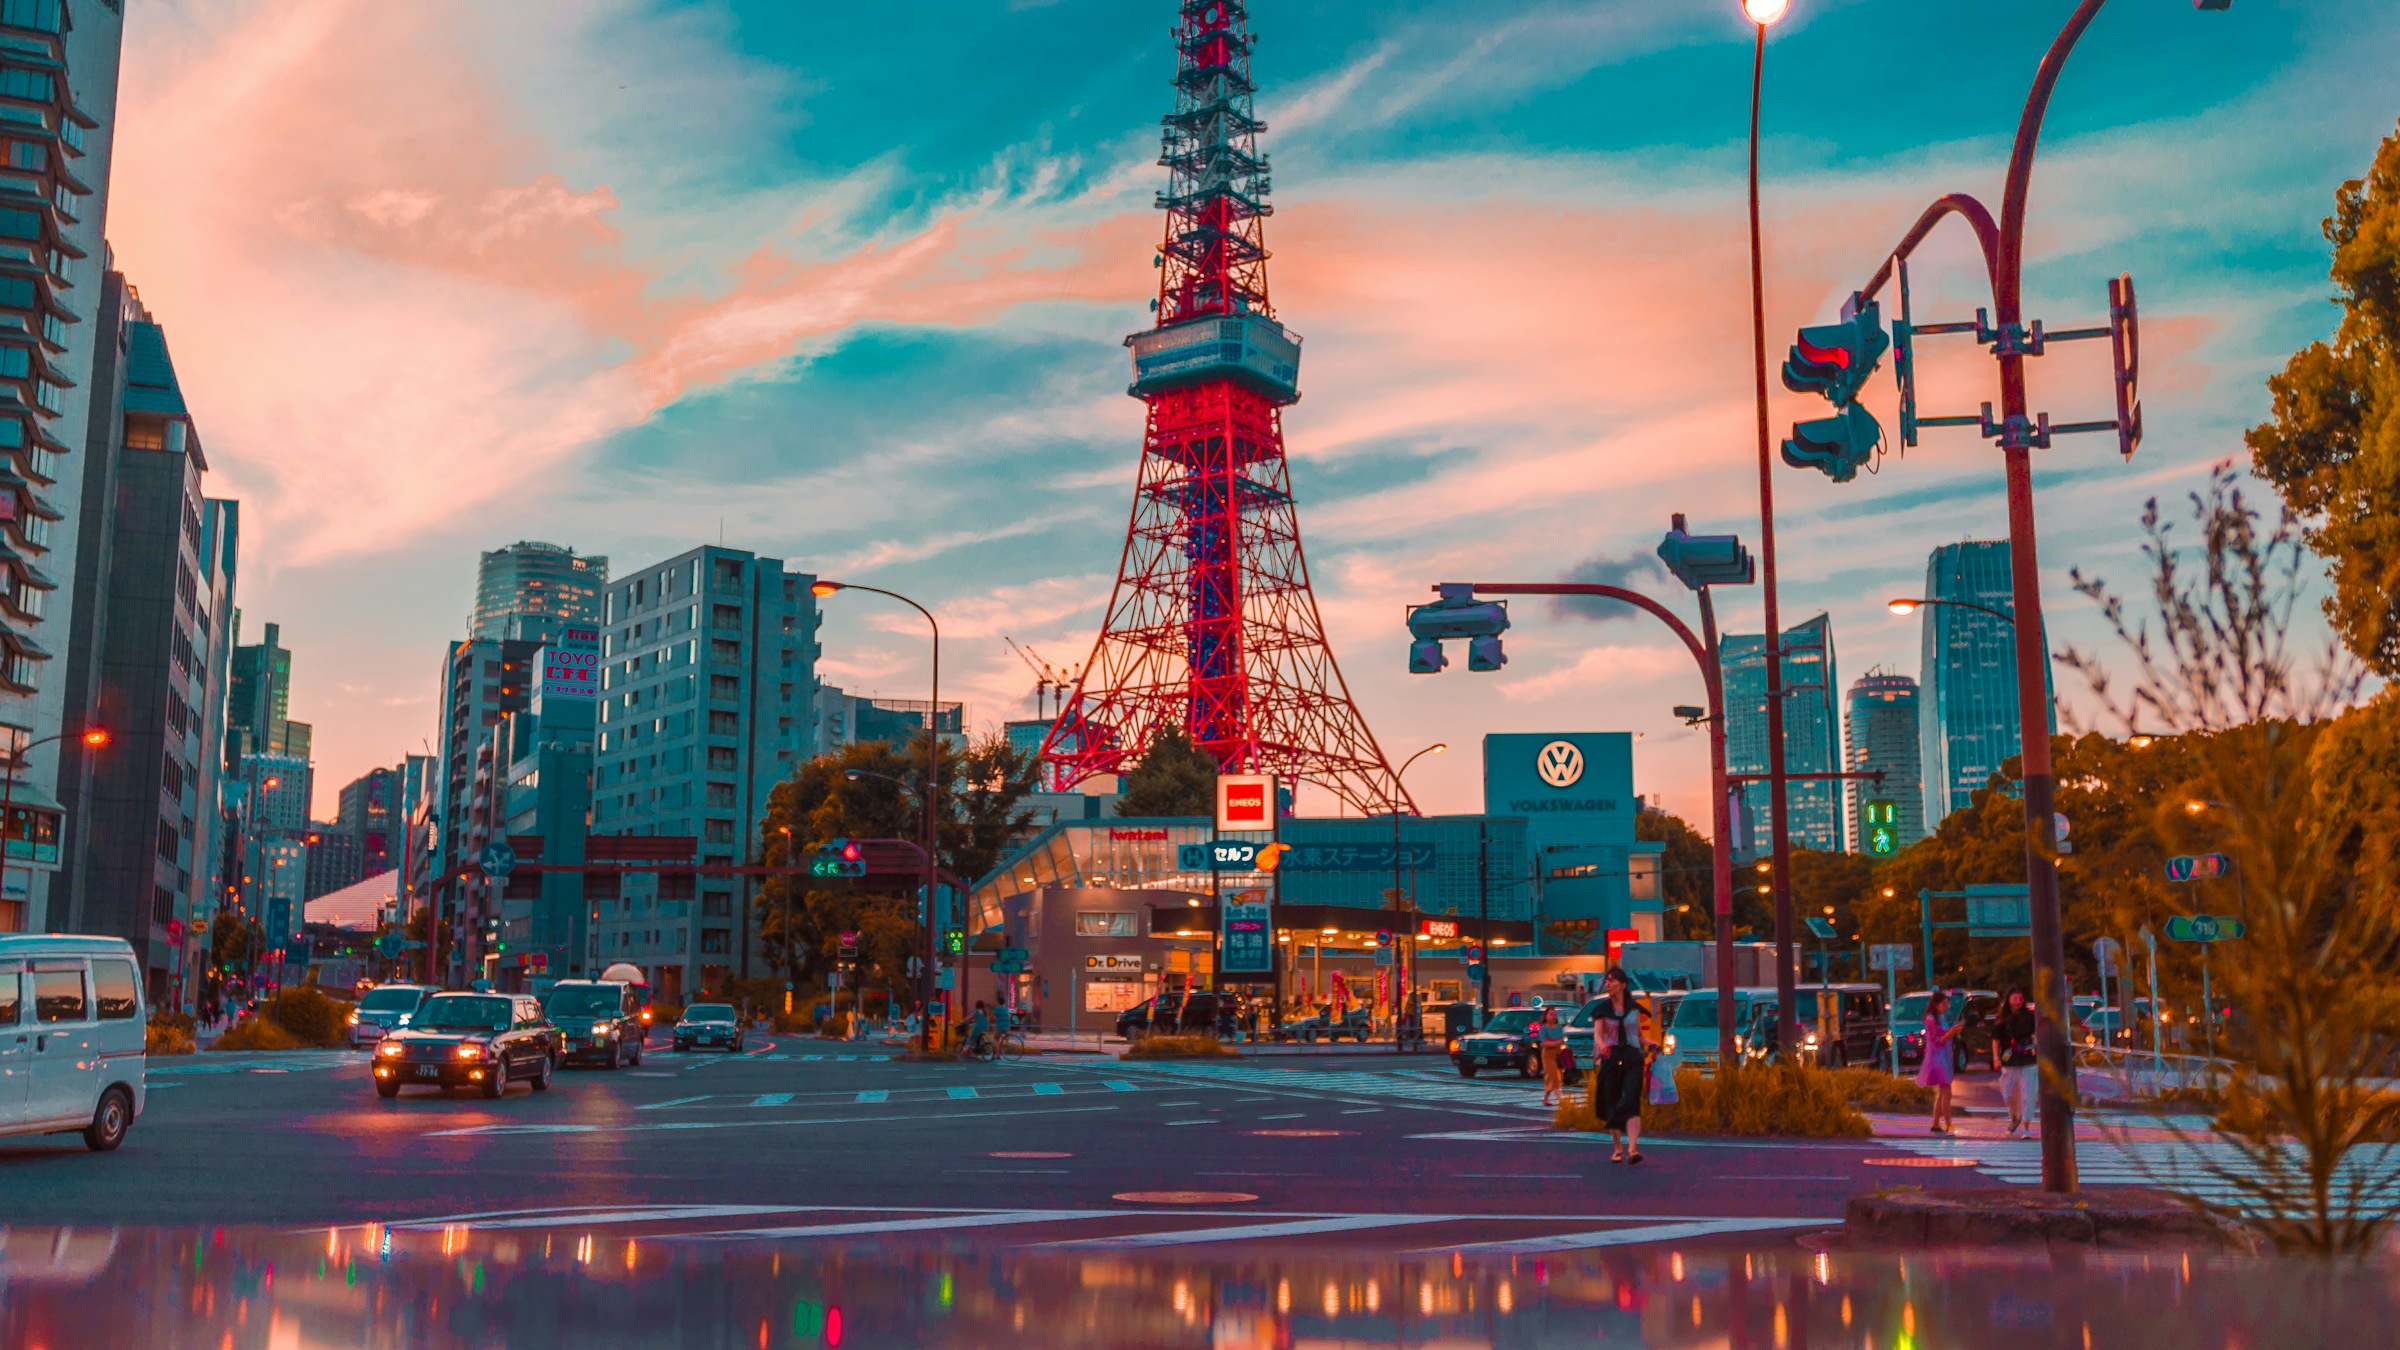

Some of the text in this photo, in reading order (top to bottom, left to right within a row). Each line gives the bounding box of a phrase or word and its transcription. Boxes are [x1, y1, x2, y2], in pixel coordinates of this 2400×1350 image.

[1228, 797, 1262, 808] ENEOS
[1509, 799, 1616, 812] VOLKSWAGEN
[1214, 846, 1254, 862] セルフ
[1283, 846, 1431, 867] 水素ステーション
[1429, 922, 1455, 937] ENEOS
[1086, 956, 1141, 968] Dr. Drive
